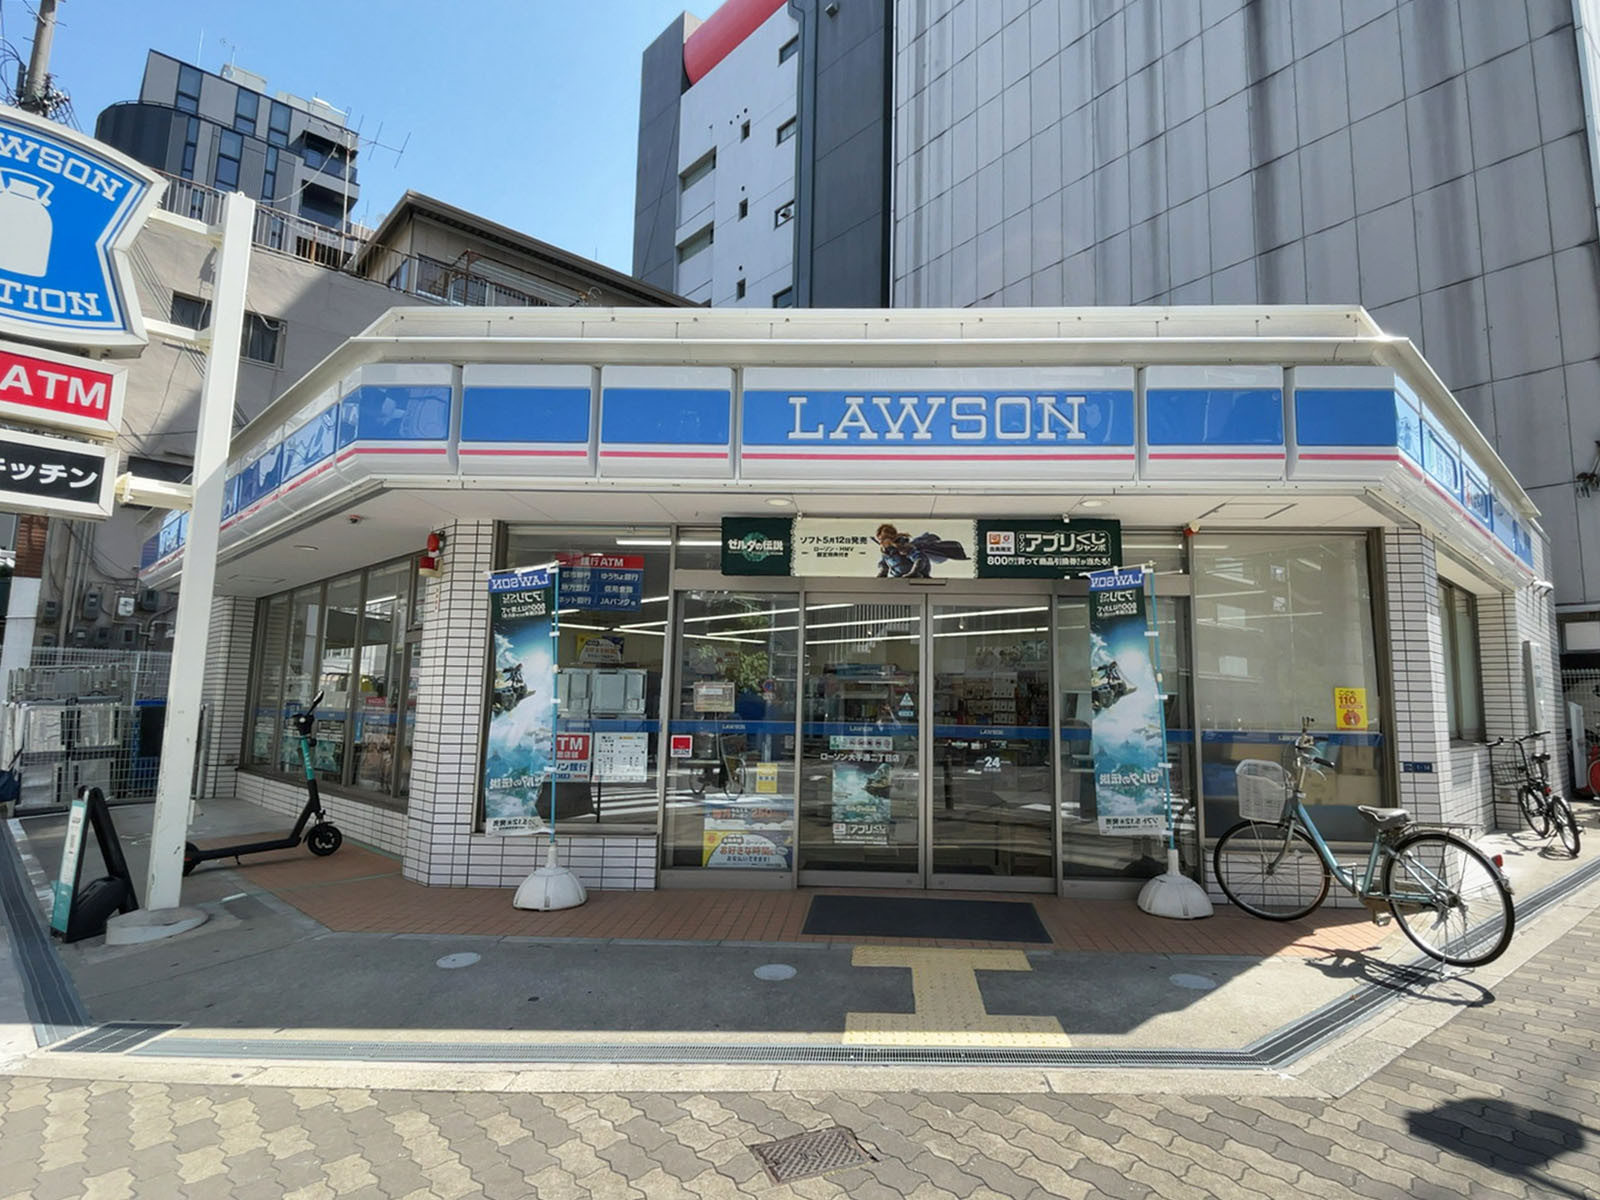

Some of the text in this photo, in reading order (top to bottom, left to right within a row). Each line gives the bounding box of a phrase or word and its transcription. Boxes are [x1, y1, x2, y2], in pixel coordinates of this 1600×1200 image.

[0, 278, 102, 316] TION
[0, 364, 107, 409] ATM
[788, 396, 1086, 440] LAWSON
[0, 458, 98, 488] ッチン
[727, 539, 784, 552] ゼルダの伝説
[557, 737, 583, 750] TM
[984, 756, 1001, 767] 24
